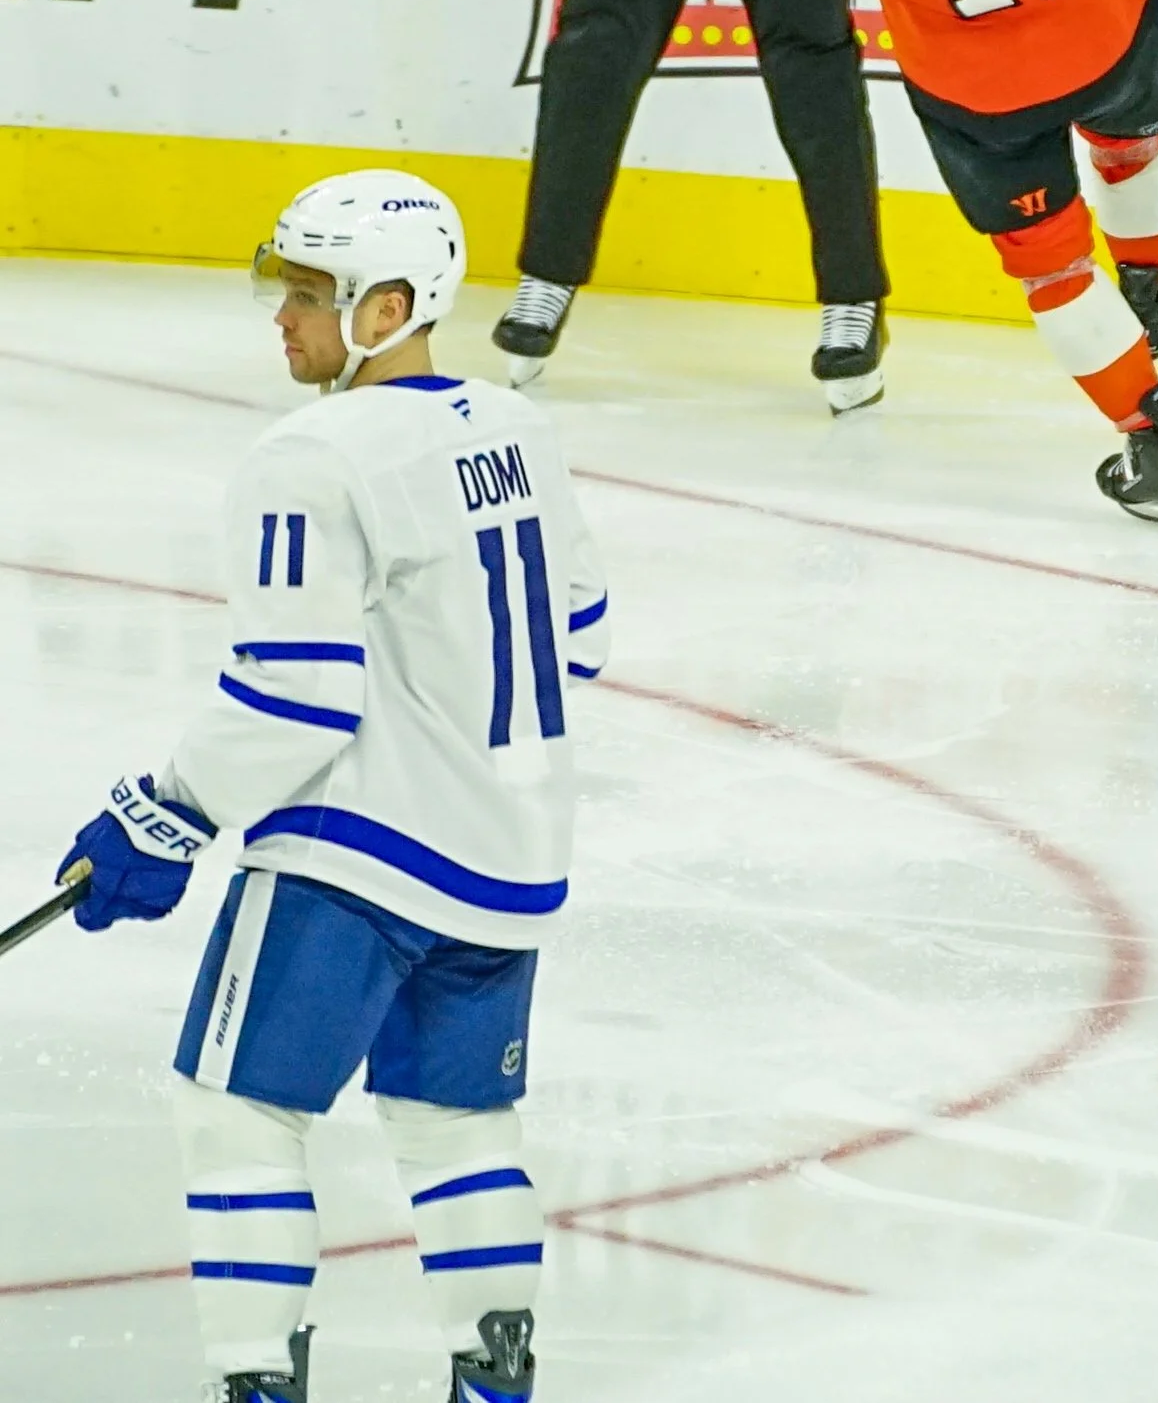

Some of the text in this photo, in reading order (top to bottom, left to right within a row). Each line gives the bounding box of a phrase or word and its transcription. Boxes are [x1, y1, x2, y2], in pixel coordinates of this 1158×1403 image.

[455, 444, 532, 512] DOMI
[259, 512, 306, 587] 11
[475, 516, 566, 749] 11
[110, 777, 203, 858] AUER
